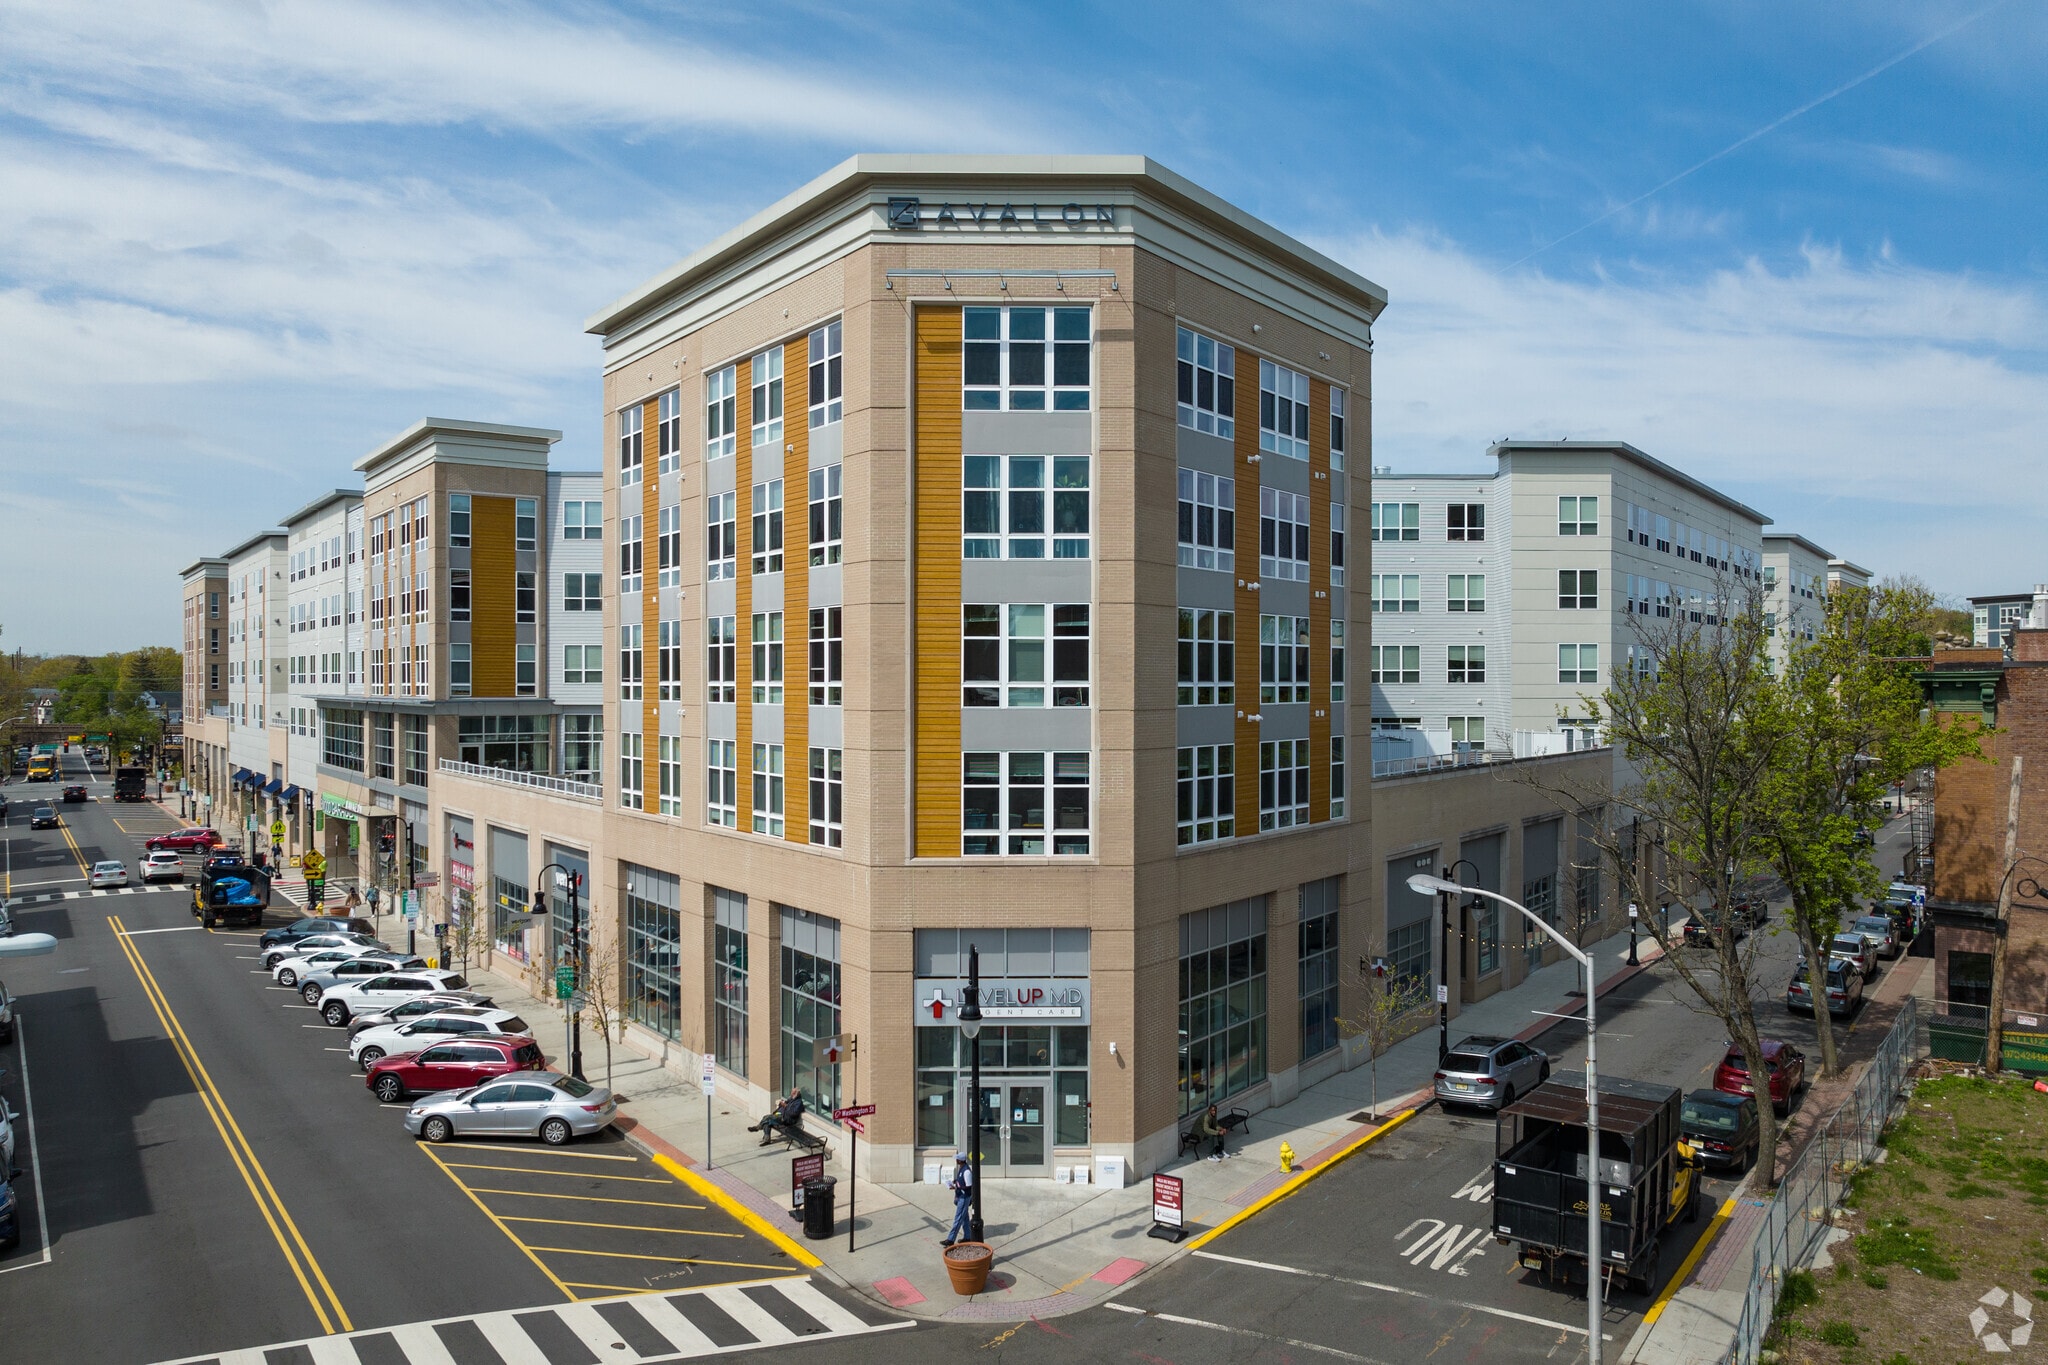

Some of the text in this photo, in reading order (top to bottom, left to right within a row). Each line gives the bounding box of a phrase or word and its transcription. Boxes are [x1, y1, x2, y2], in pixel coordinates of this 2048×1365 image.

[936, 202, 1115, 225] AVALON
[956, 988, 1083, 1005] LVELUP MD
[841, 1107, 868, 1117] Washington
